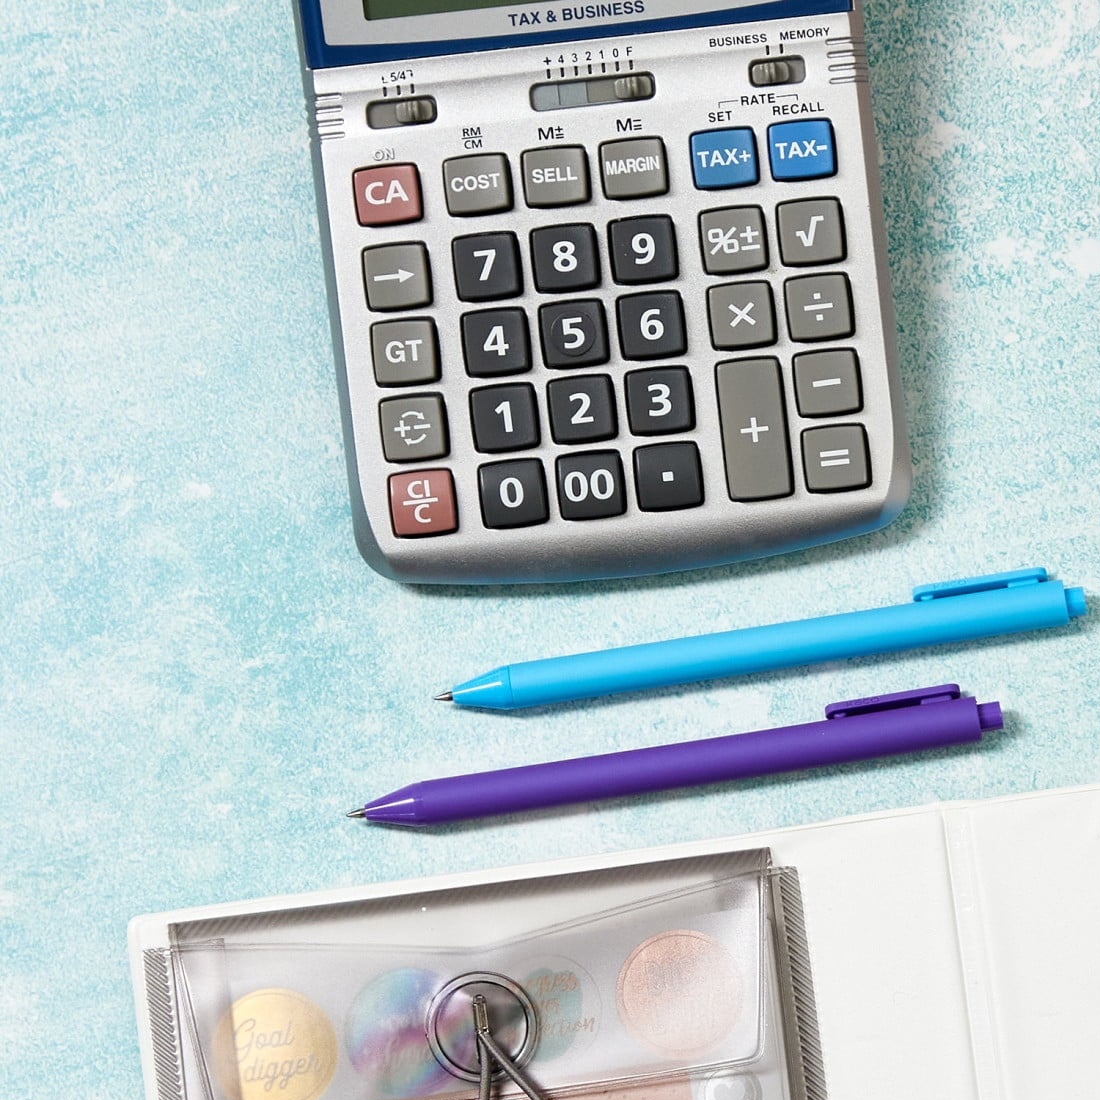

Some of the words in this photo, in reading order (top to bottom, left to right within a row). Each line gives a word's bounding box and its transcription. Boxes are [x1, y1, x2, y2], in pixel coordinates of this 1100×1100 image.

[508, 11, 541, 27] TAX
[546, 10, 557, 23] &
[562, 1, 645, 21] BUSINESS
[709, 34, 767, 47] BUSINESS
[780, 27, 830, 41] MEMORY
[558, 55, 565, 64] 4
[572, 53, 578, 62] 3
[585, 51, 592, 61] 2
[612, 48, 619, 58] 0
[626, 46, 633, 56] F
[708, 111, 732, 122] SET
[773, 102, 824, 116] RECALL
[741, 93, 776, 106] RATE
[462, 127, 481, 137] RM
[464, 139, 482, 149] CM
[372, 148, 395, 161] ON
[697, 149, 751, 168] TAX+
[775, 140, 827, 159] TAX-
[532, 166, 578, 184] SELL
[605, 156, 660, 175] MARGIN
[365, 180, 409, 205] CA
[451, 173, 500, 192] COST
[553, 240, 578, 273] 8
[631, 233, 656, 265] 9
[473, 250, 496, 281] 7
[563, 317, 585, 350] 5
[640, 308, 665, 340] 6
[385, 339, 422, 364] GT
[483, 326, 509, 357] 4
[569, 392, 594, 424] 2
[648, 384, 671, 417] 3
[494, 401, 514, 432] 1
[500, 477, 524, 508] 0
[564, 468, 615, 502] 00
[414, 504, 431, 524] C
[244, 1053, 322, 1092] digger
